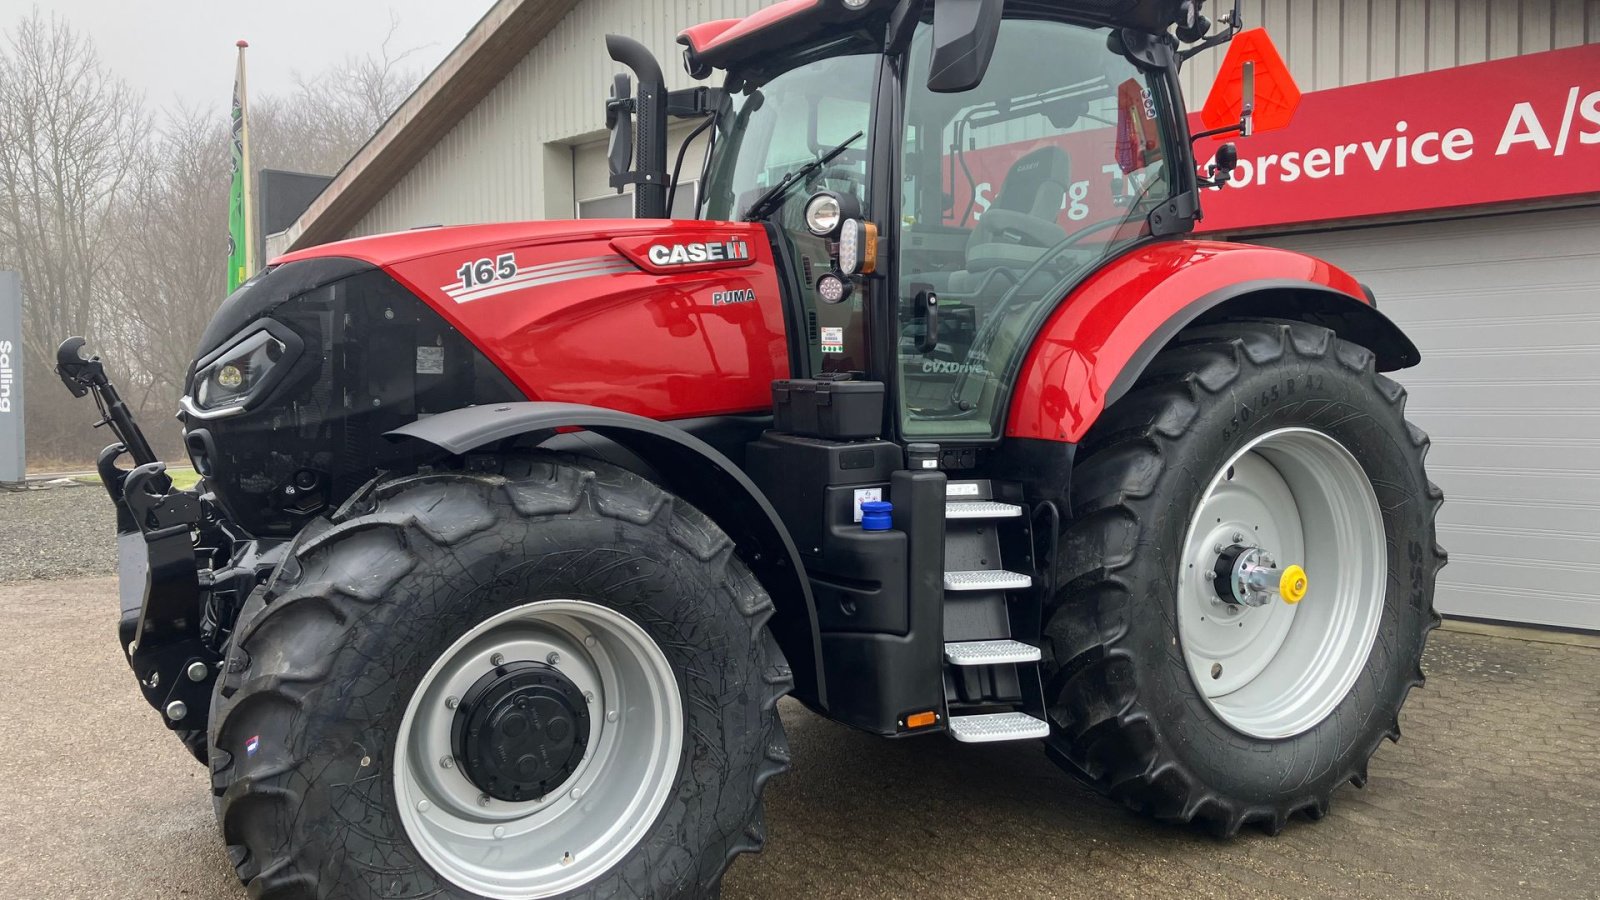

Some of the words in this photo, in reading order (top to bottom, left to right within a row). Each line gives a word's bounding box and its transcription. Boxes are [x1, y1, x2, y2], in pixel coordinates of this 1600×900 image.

[648, 241, 724, 266] CASE
[456, 252, 518, 291] 165
[712, 288, 756, 306] PUMA
[0, 340, 13, 413] Salling
[922, 361, 985, 374] CVXDrive
